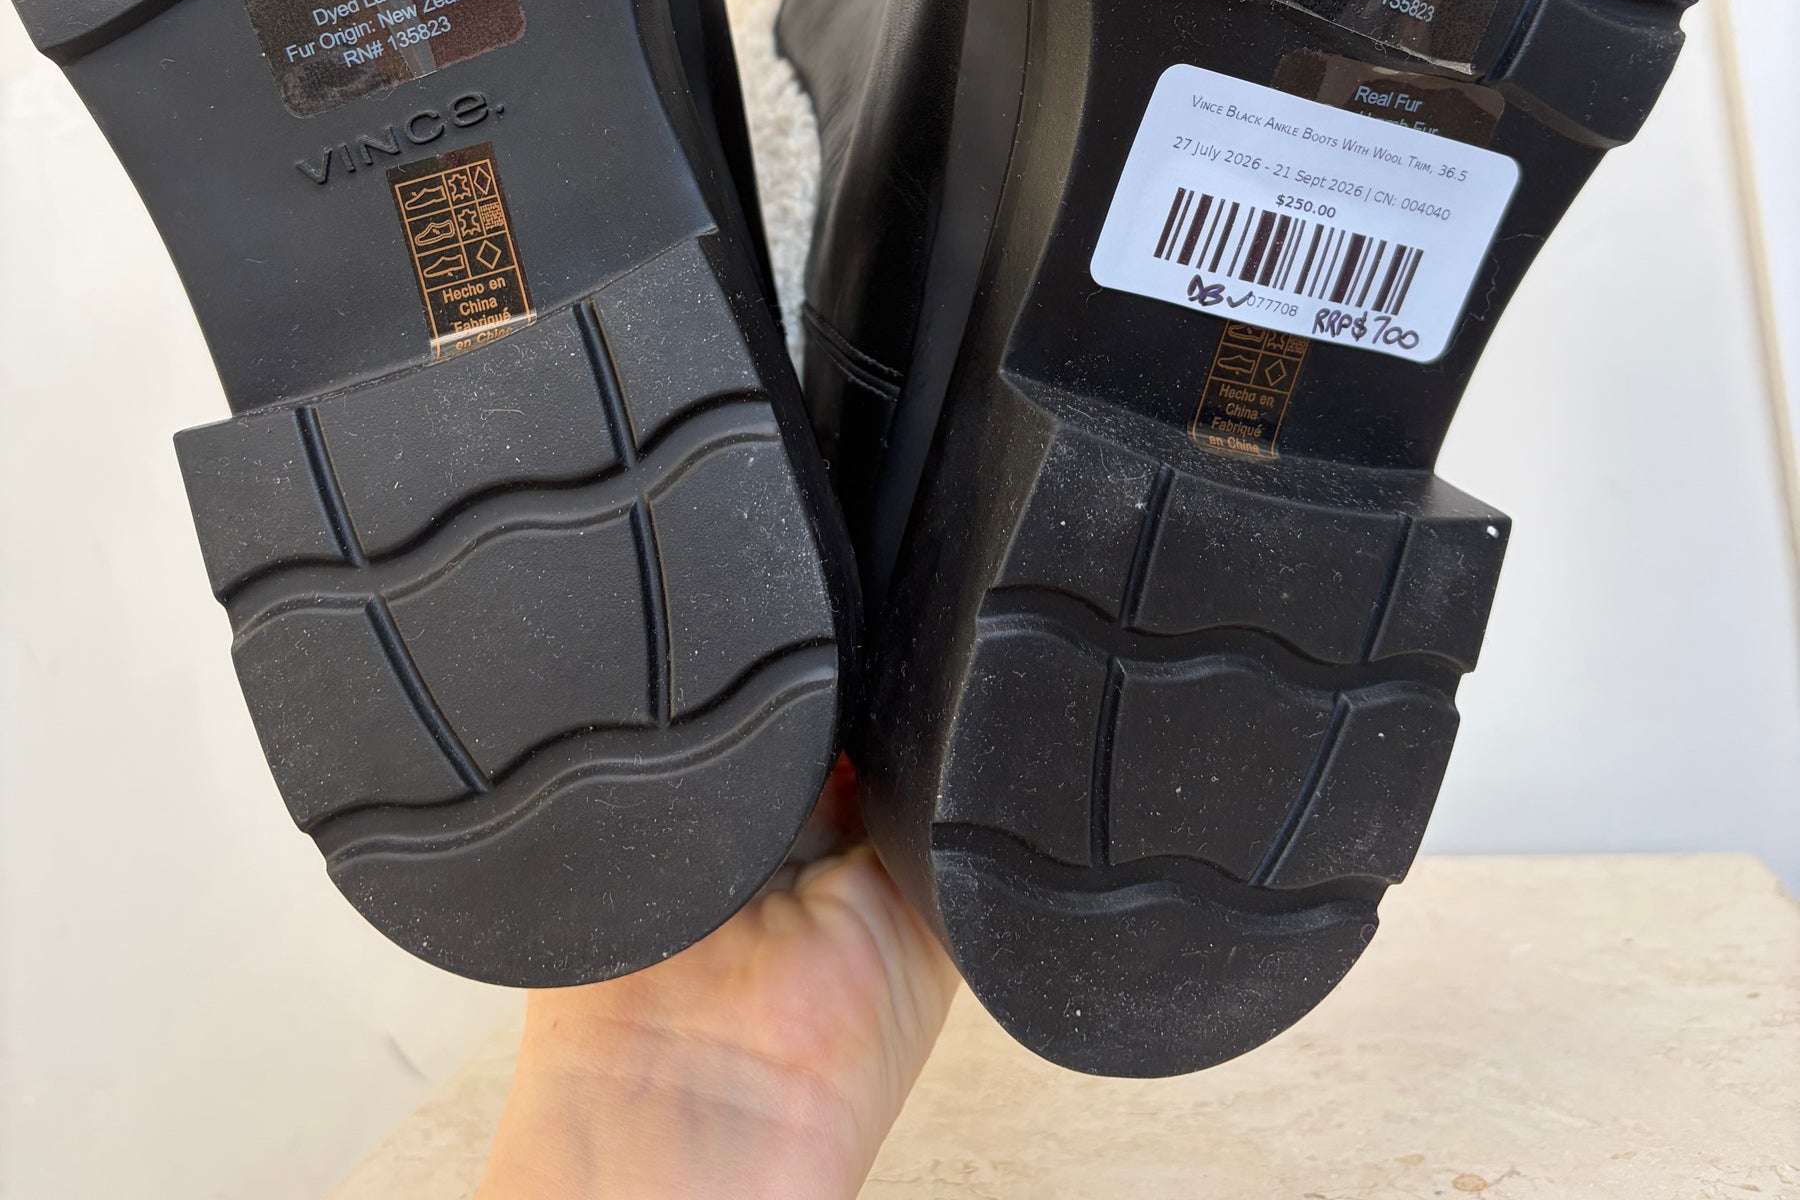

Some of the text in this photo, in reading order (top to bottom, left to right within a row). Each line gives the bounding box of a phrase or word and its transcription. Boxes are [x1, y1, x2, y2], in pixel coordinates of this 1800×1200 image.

[286, 41, 316, 63] Fur
[319, 20, 376, 50] Origin:
[377, 3, 418, 29] New
[343, 16, 451, 68] RN# 135823
[1354, 85, 1423, 112] Real Fur
[1173, 136, 1193, 151] 27
[1192, 141, 1221, 161] July
[1224, 150, 1262, 170] 2026
[1273, 163, 1291, 179] 21
[1295, 169, 1327, 188] Sept
[1328, 179, 1364, 197] 2026
[1374, 190, 1397, 206] CN:
[1401, 198, 1451, 221] 004040
[1437, 164, 1469, 182] 36.5
[1275, 193, 1336, 218] $250.00
[442, 277, 506, 304] Hecho en
[460, 297, 498, 316] China
[453, 306, 512, 333] Fabriqué
[455, 339, 471, 350] en
[1219, 383, 1274, 407] Hecho en
[1225, 402, 1258, 420] China
[1211, 416, 1263, 438] Fabriqué
[1208, 435, 1260, 454] en Chine
